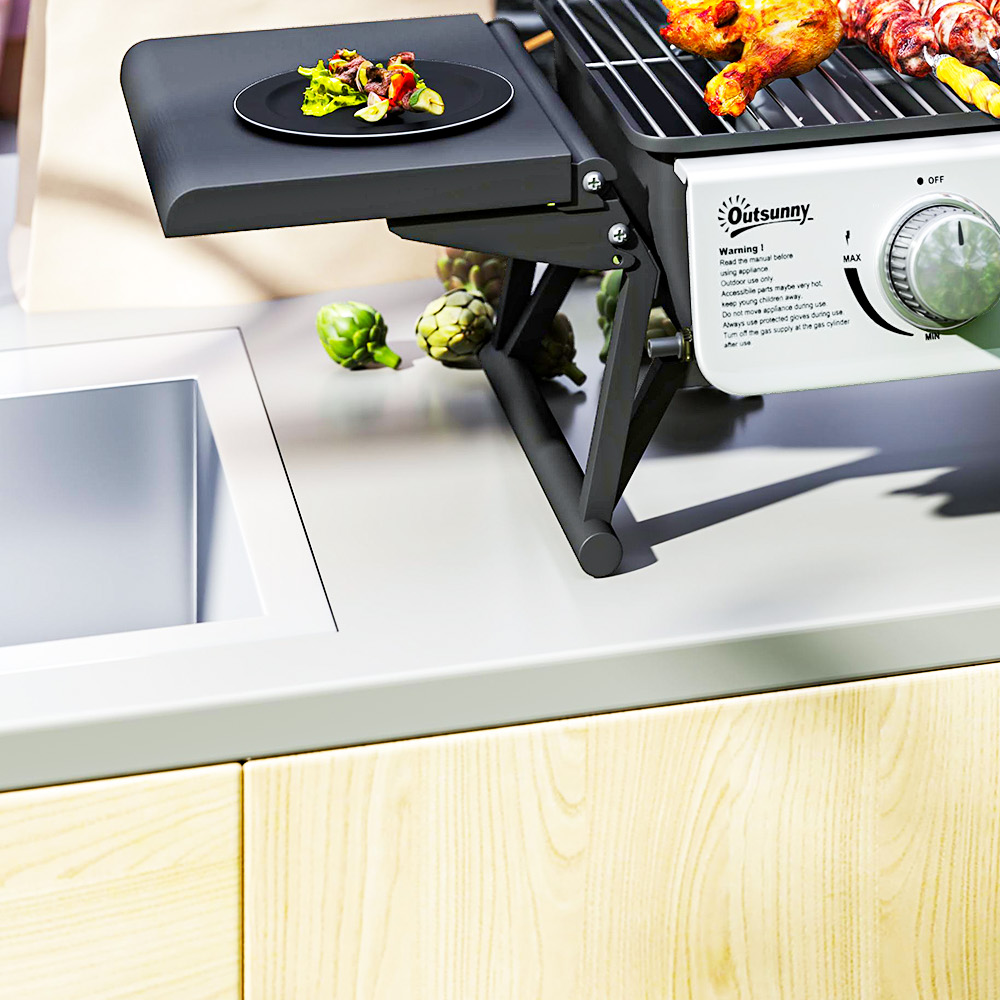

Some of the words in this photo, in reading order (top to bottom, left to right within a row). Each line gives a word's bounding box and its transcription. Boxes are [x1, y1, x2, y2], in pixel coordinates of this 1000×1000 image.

[928, 176, 944, 184] OFF
[728, 204, 810, 225] Outsunny
[719, 246, 758, 255] Warning
[750, 255, 772, 263] manual
[843, 254, 861, 263] MAX
[739, 266, 768, 275] appliance
[721, 279, 746, 287] Outdoor
[739, 298, 757, 307] young
[759, 295, 783, 303] children
[764, 304, 792, 313] appliance
[794, 302, 813, 310] during
[723, 320, 745, 328] Always
[760, 316, 788, 325] protected
[790, 313, 809, 321] gloves
[811, 310, 830, 318] during
[774, 325, 793, 333] supply
[826, 319, 849, 327] cylinder
[925, 332, 940, 340] MIN
